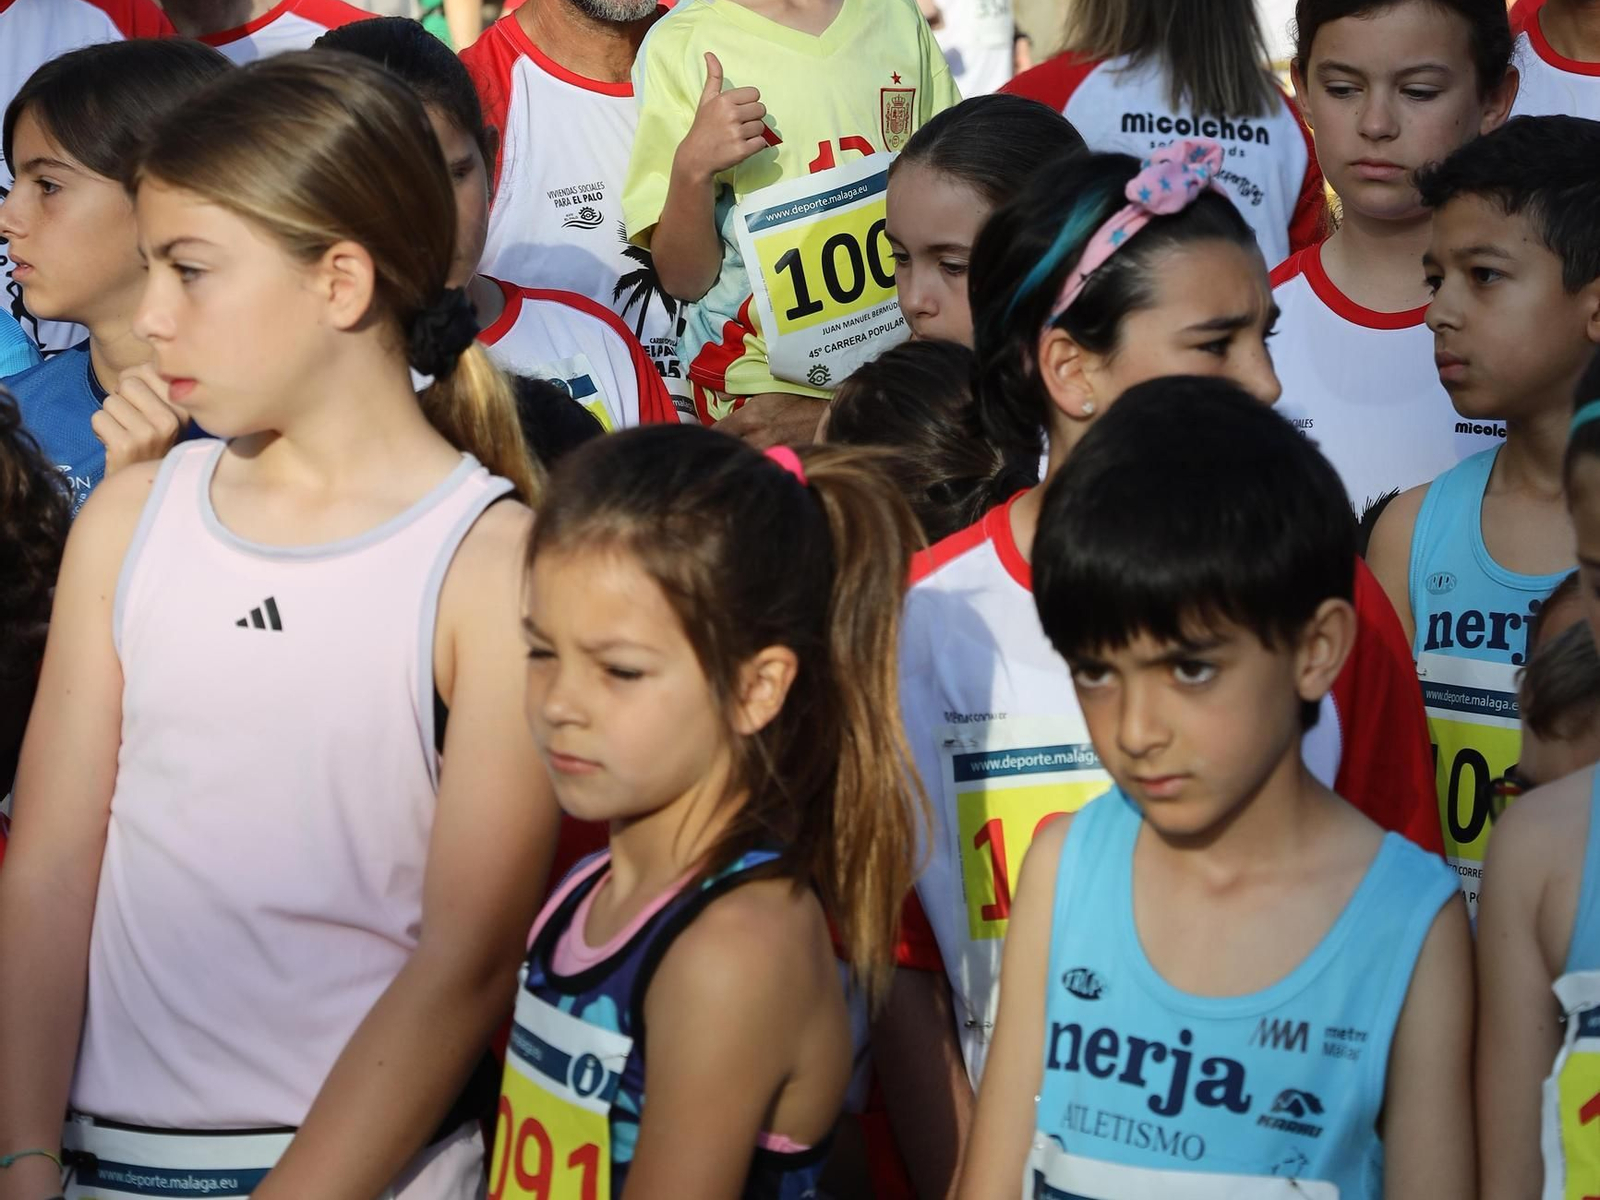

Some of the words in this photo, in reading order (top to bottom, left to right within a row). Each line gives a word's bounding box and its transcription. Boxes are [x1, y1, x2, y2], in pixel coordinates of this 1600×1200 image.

[547, 185, 578, 200] VIVIENDAS
[578, 181, 605, 193] SOCIALES
[554, 197, 572, 208] PARA
[572, 195, 583, 205] EL
[583, 191, 603, 203] PALO
[766, 184, 868, 222] www.deporte.malaga.eu
[822, 323, 841, 336] JUAN
[842, 313, 871, 329] MANUEL
[824, 332, 867, 354] CARRERA
[868, 316, 905, 339] POPULAR
[1046, 1020, 1253, 1117] nerja
[1060, 1101, 1206, 1161] ATLETISMO
[98, 1167, 238, 1193] www.deporte.malaga.eu
